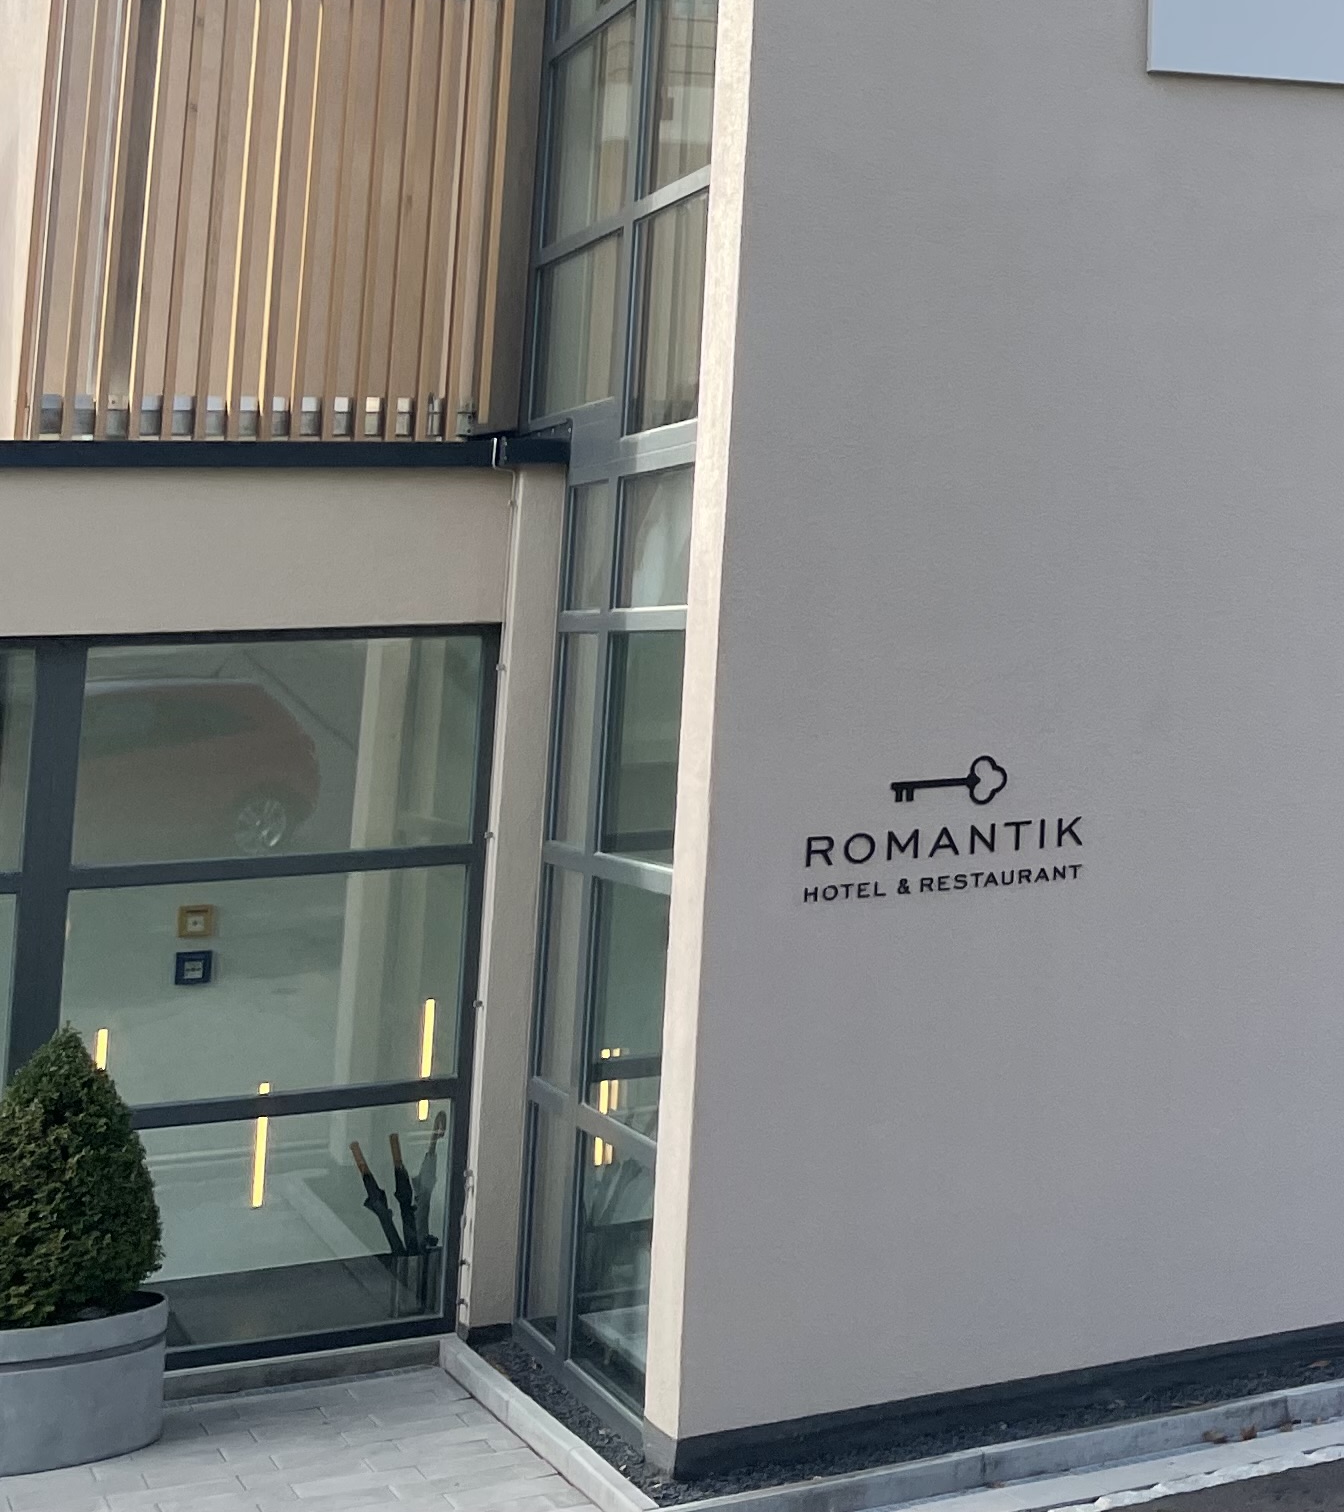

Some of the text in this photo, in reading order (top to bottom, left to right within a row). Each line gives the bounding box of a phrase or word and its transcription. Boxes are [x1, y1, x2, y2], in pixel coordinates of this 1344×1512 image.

[805, 816, 1083, 867] ROMANTIK
[803, 864, 1083, 903] HOTEL & RESTAURANT
